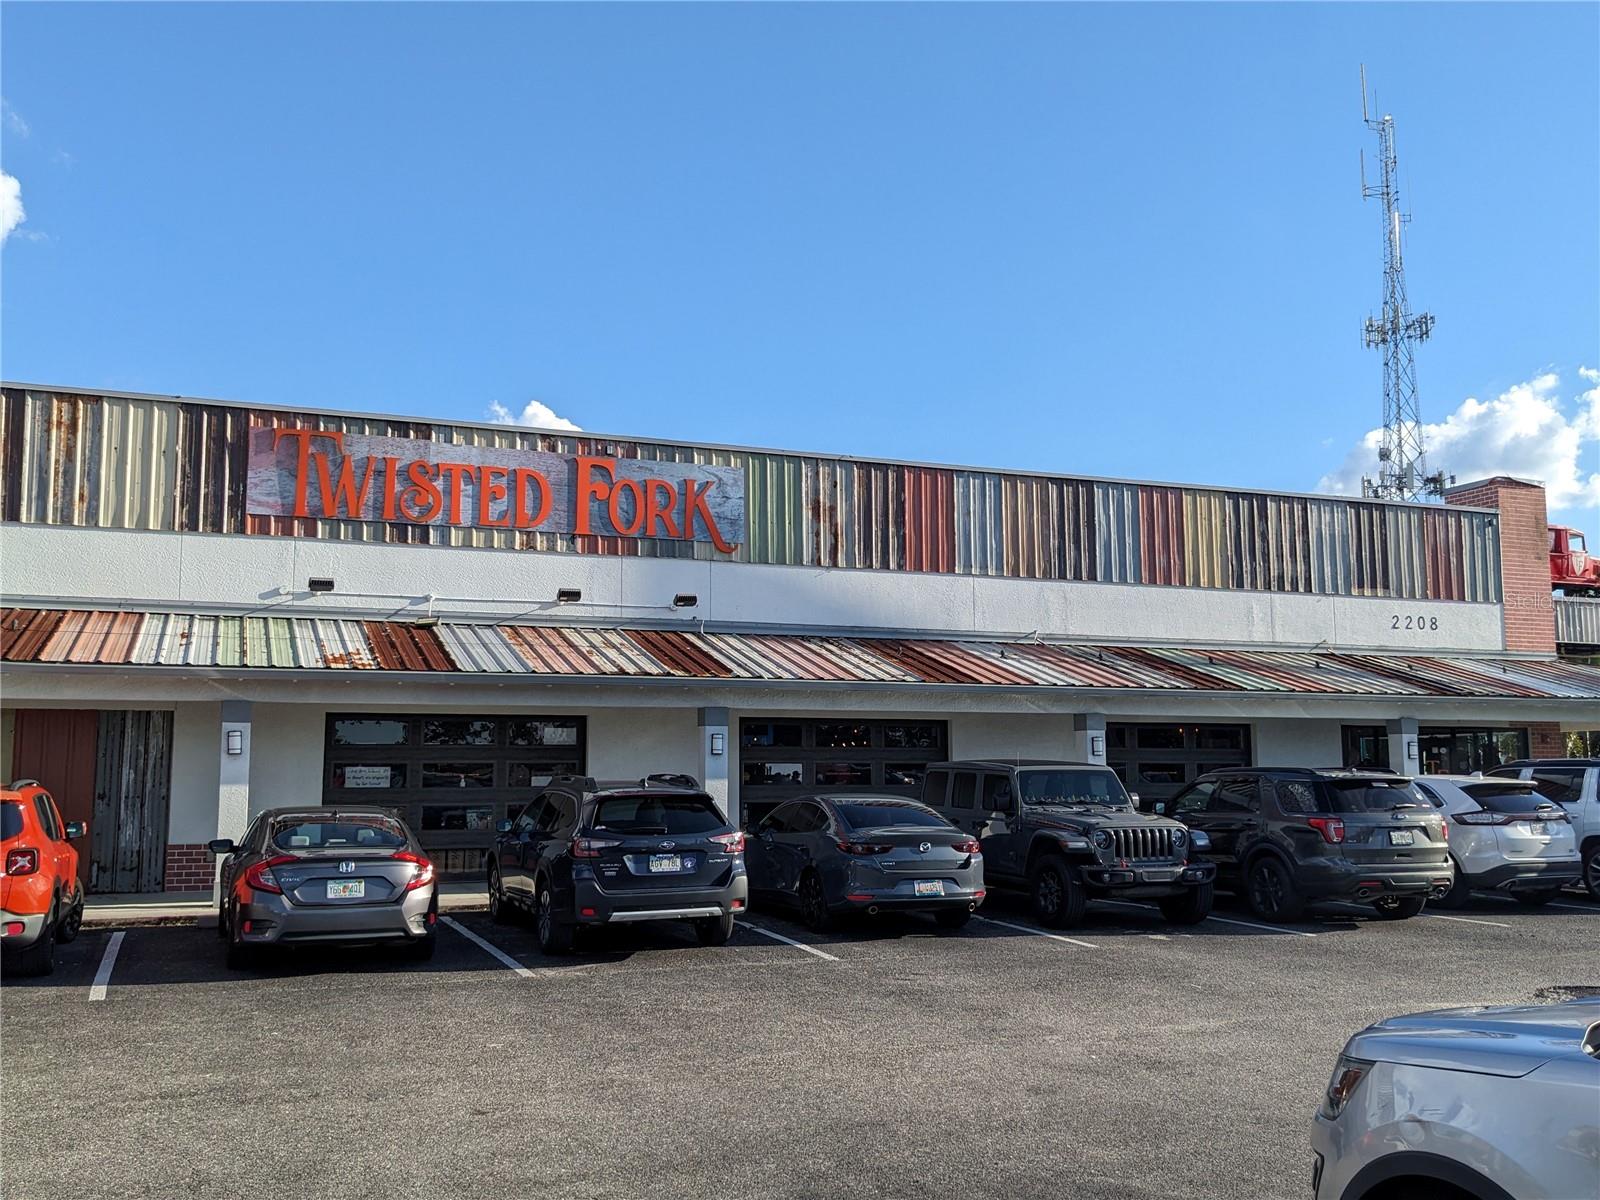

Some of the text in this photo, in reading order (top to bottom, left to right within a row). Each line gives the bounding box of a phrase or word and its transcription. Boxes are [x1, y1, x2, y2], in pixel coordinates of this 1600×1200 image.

[272, 428, 738, 554] TWISTED FORK
[1391, 615, 1439, 631] 2208
